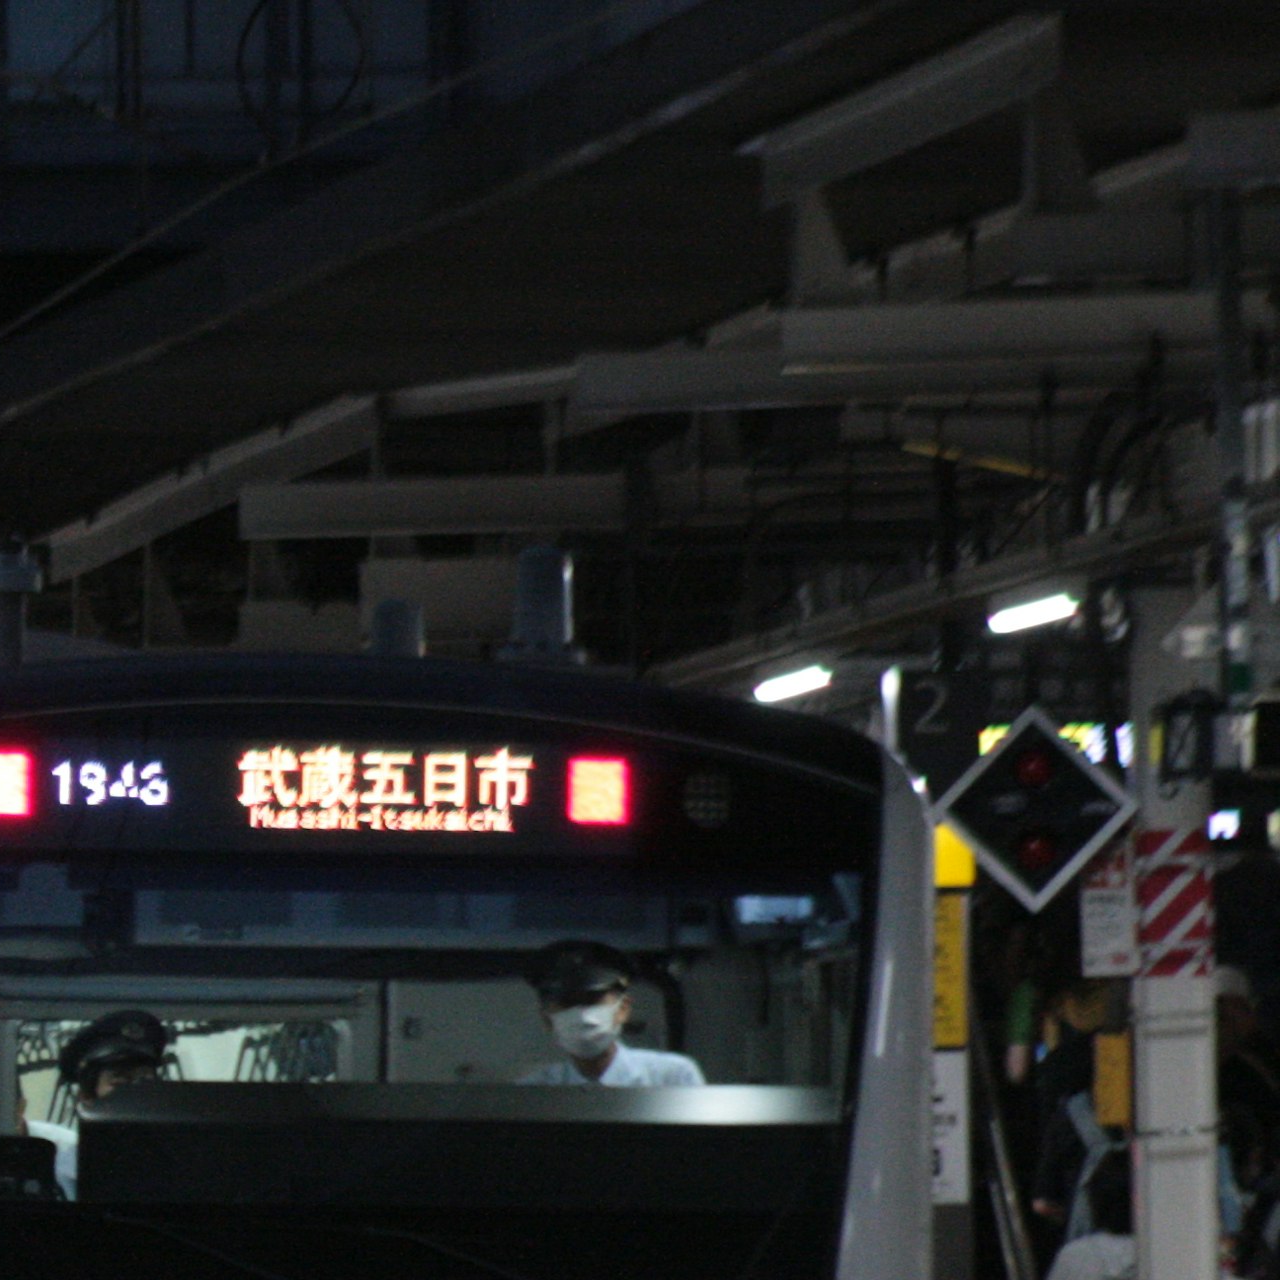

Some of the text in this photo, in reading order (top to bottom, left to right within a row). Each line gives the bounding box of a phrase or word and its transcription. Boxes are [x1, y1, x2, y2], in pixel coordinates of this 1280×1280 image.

[237, 745, 533, 807] 武蔵五日市
